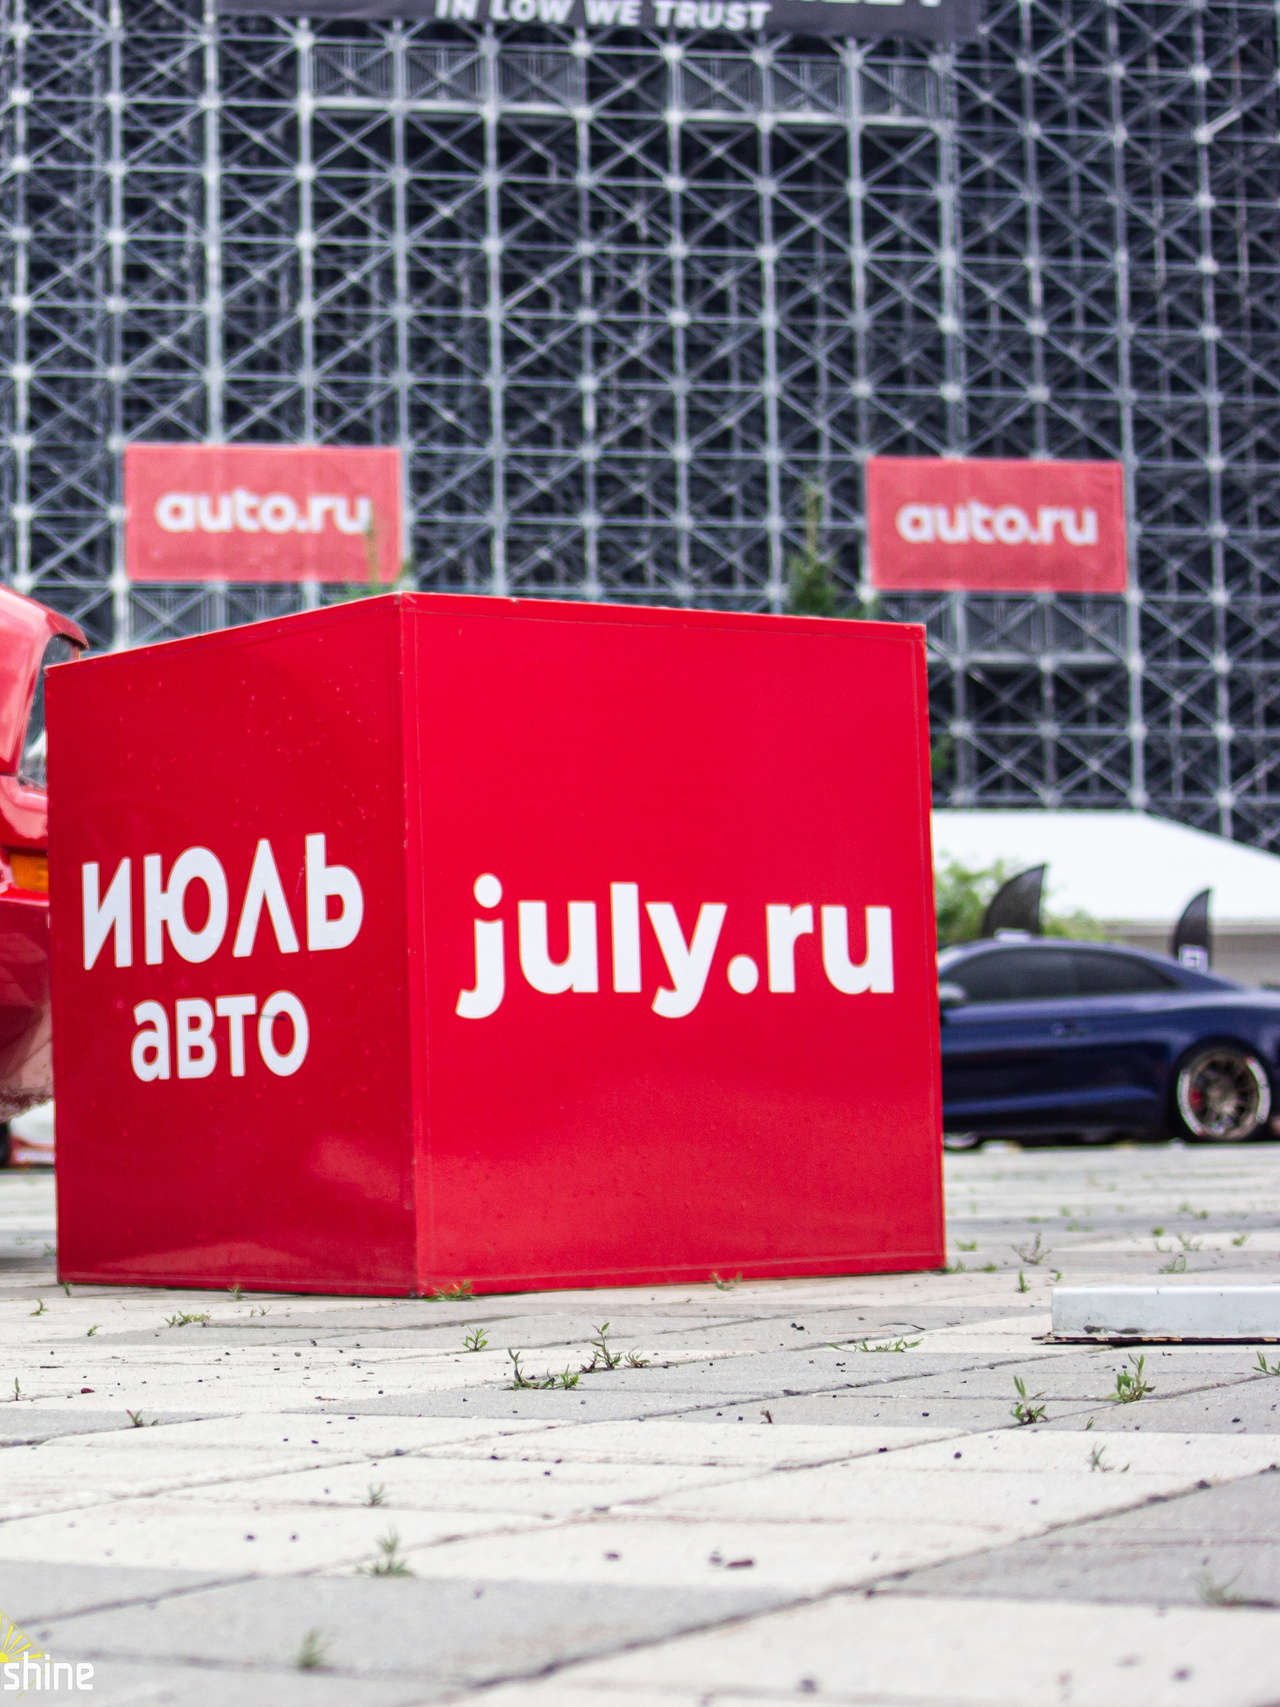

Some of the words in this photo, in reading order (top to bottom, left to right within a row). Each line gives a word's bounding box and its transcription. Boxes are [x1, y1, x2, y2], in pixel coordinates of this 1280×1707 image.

[434, 0, 478, 21] IN
[489, 0, 575, 24] LOW
[584, 0, 641, 26] WE
[652, 0, 771, 31] TRUST
[155, 487, 372, 535] auto.ru
[896, 500, 1098, 546] auto.ru
[456, 873, 895, 1019] july.ru
[131, 991, 310, 1082] авто
